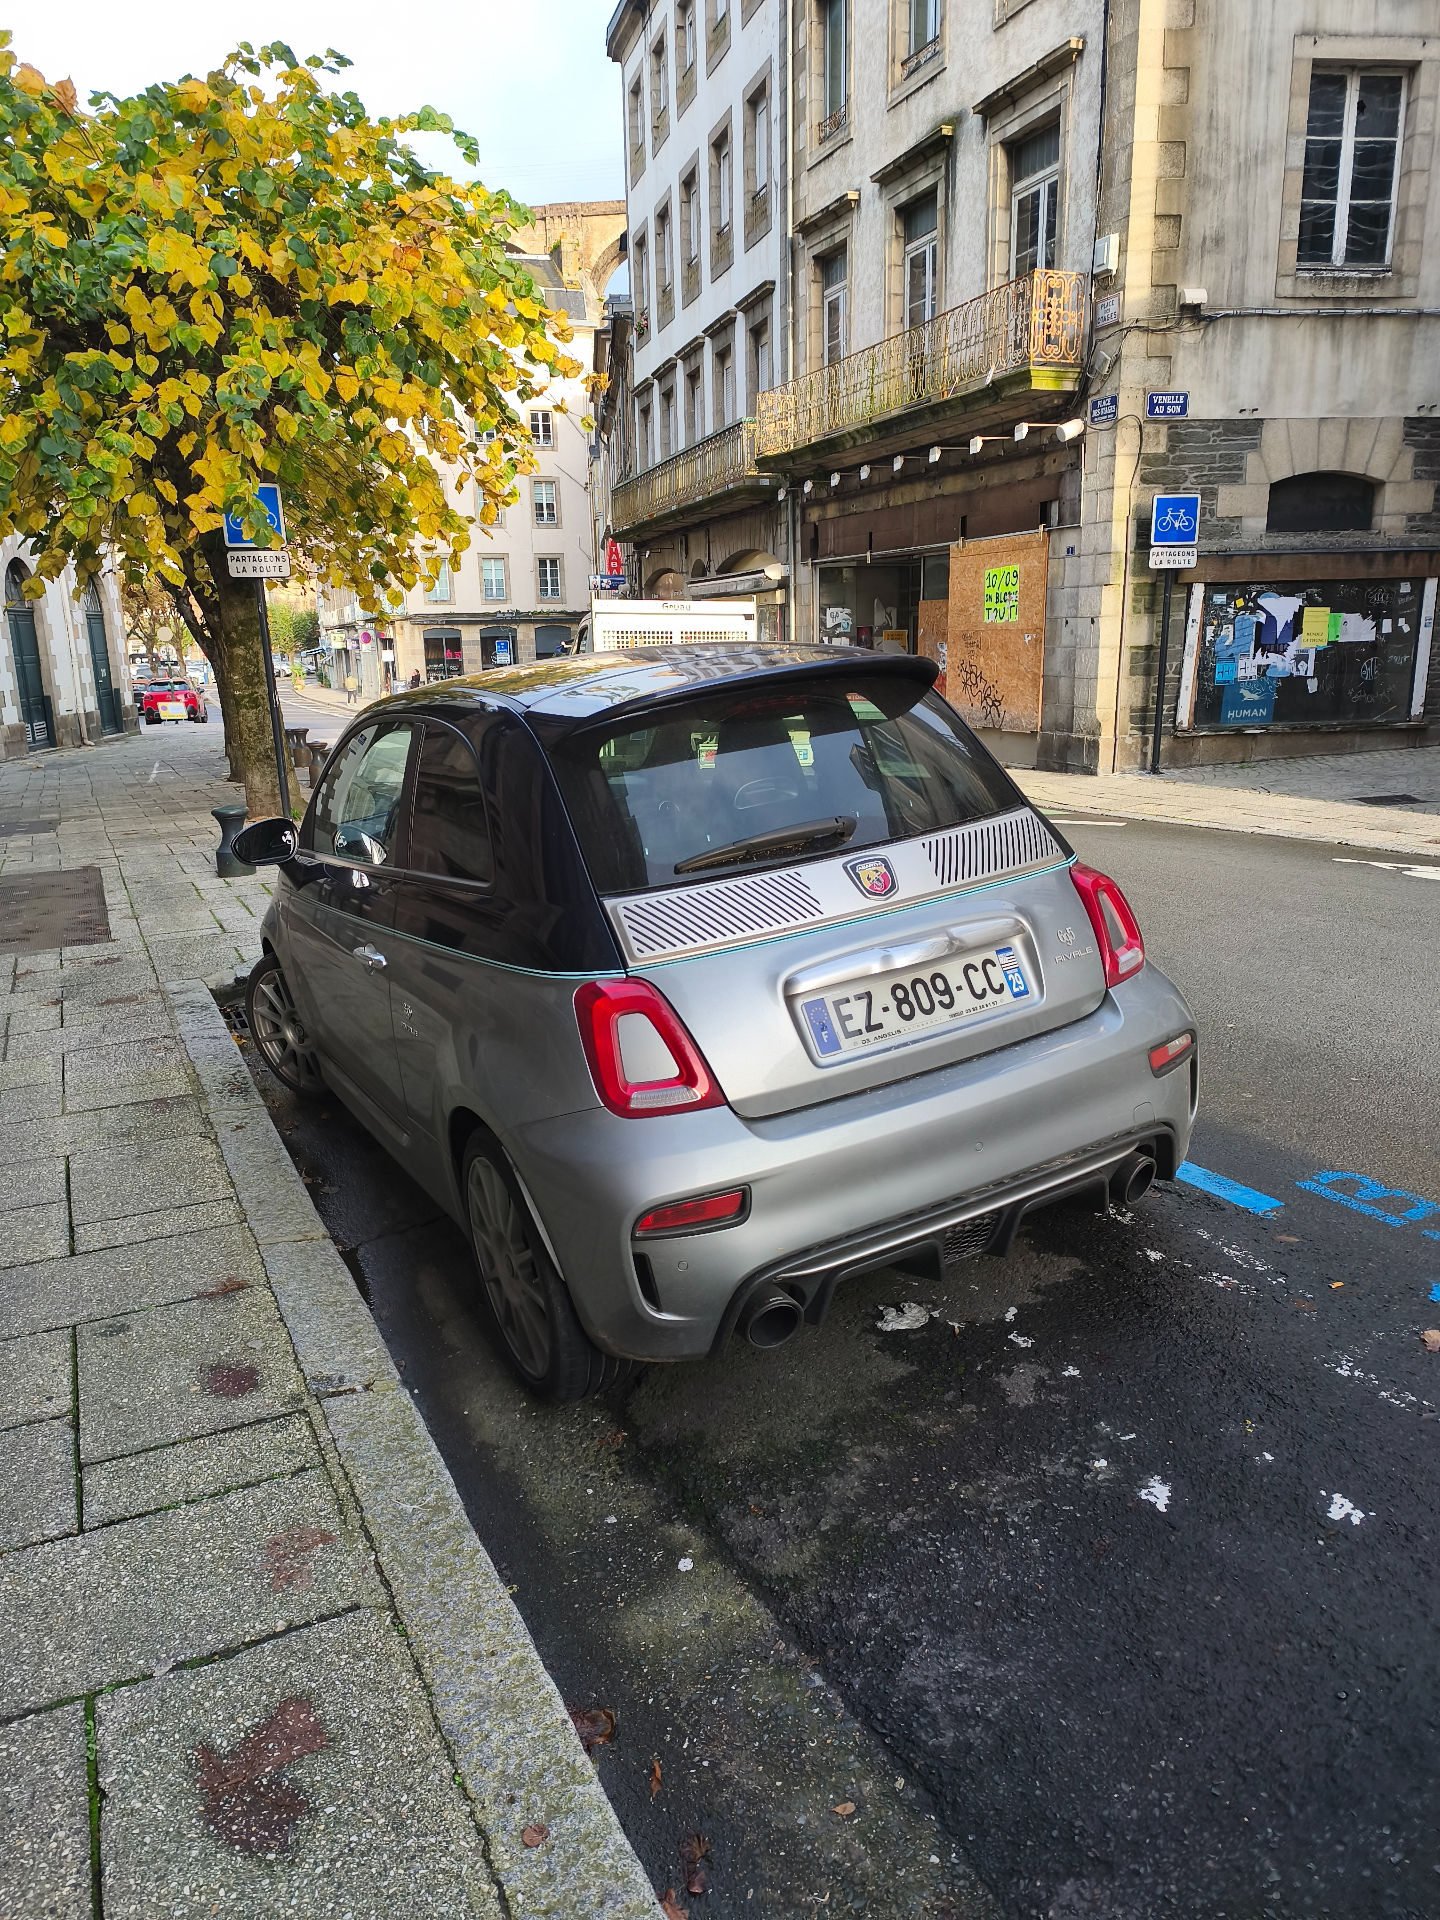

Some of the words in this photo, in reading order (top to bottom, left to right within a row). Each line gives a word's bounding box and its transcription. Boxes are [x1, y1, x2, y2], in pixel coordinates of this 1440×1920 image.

[1100, 300, 1115, 310] PLACE
[1097, 397, 1112, 408] PLACE
[1153, 395, 1185, 404] VENELLE
[1153, 405, 1164, 414] AU
[1166, 405, 1182, 414] SON
[230, 555, 287, 563] PARTAGEONS
[1151, 550, 1196, 558] PARTAGEONS
[235, 566, 248, 574] LA
[252, 565, 284, 573] ROUTE
[986, 569, 1019, 591] 10/09
[1227, 708, 1267, 718] HUMAN
[1054, 946, 1094, 964] RIVALE
[1008, 972, 1025, 993] 29
[832, 958, 1005, 1039] EZ-809-CC
[821, 1030, 829, 1043] F
